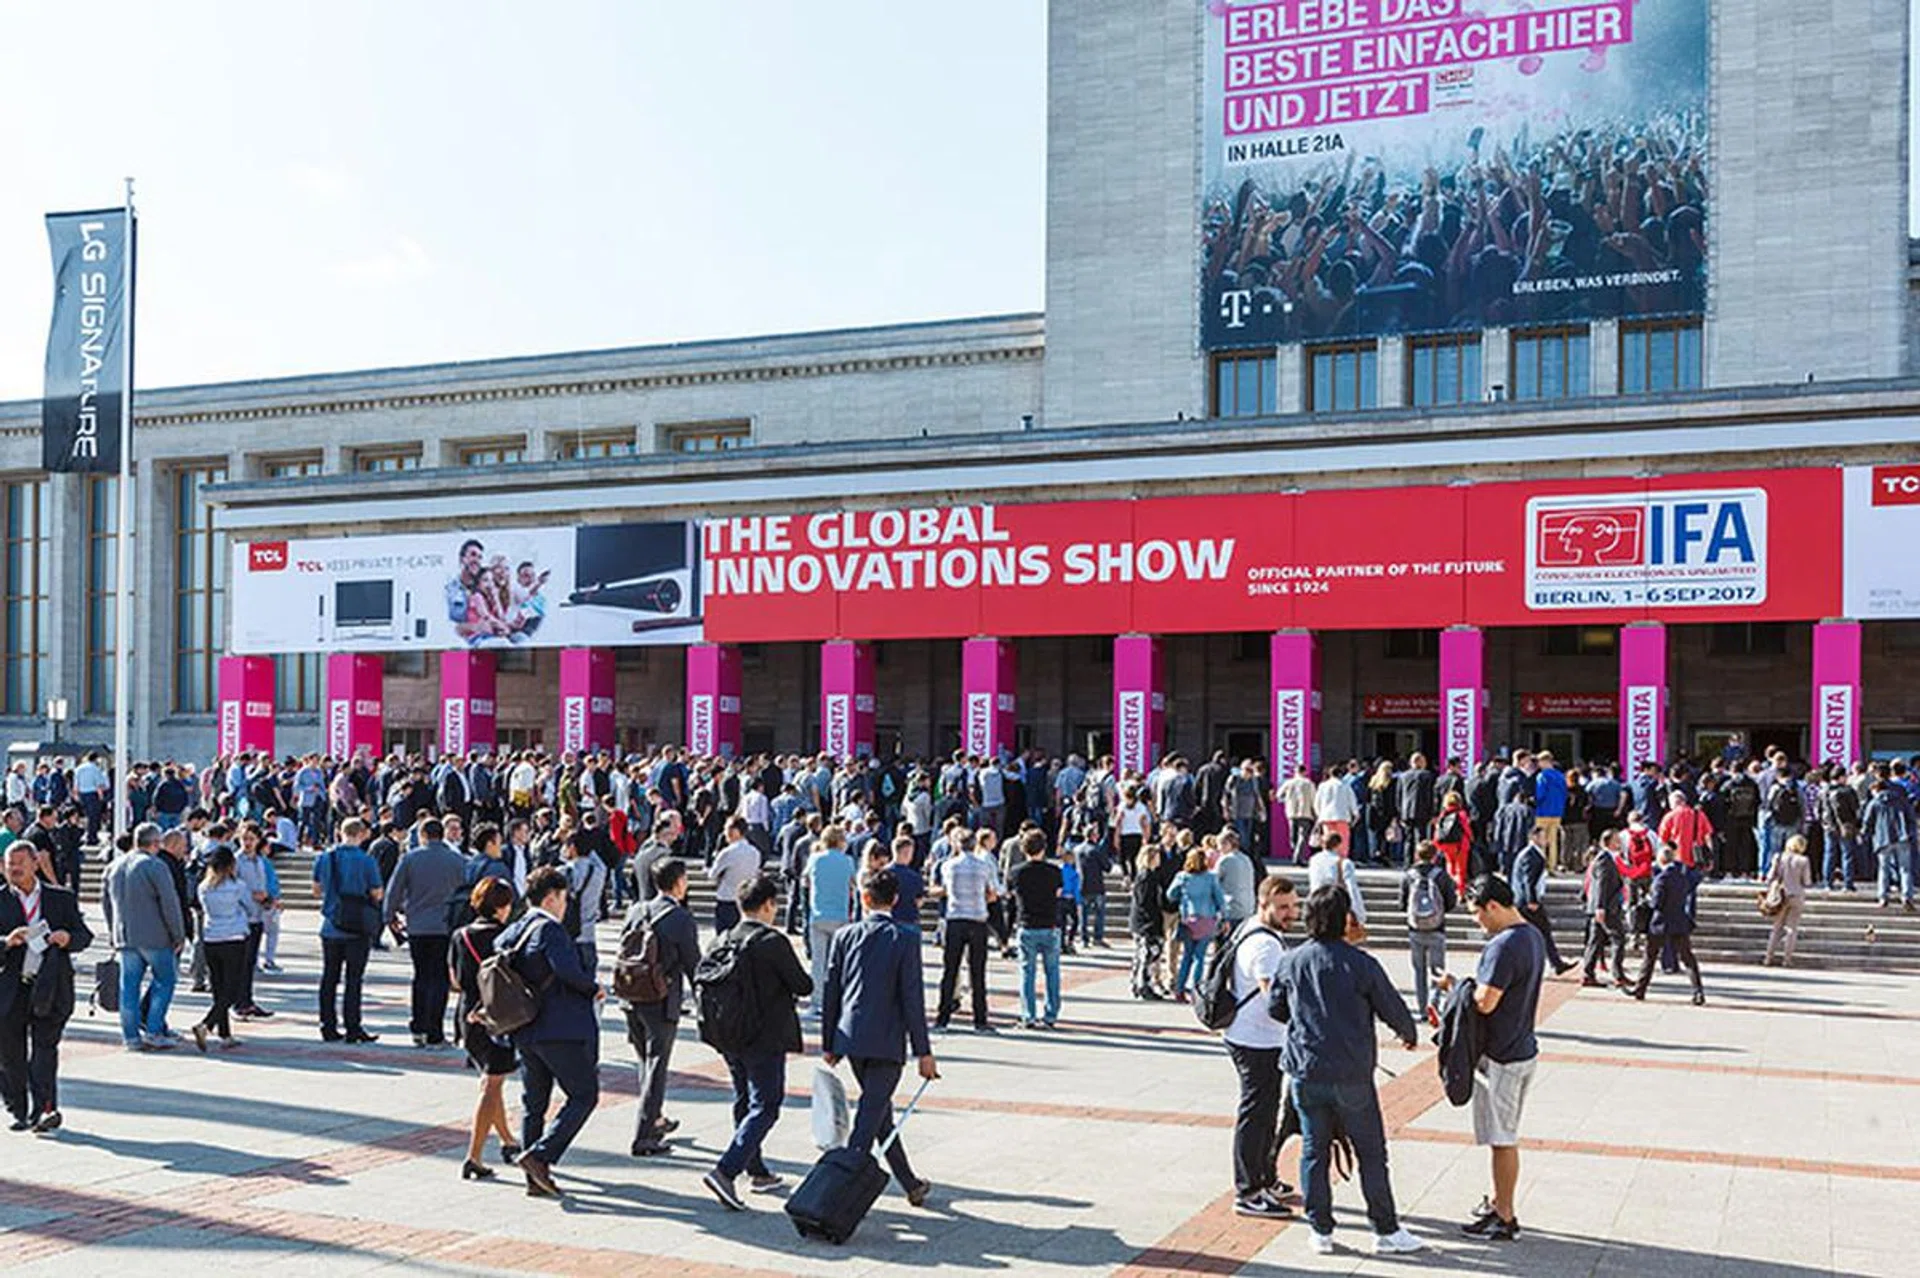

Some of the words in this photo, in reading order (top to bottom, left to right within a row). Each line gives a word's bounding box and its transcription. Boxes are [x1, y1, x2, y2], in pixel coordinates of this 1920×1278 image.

[1228, 0, 1369, 43] ERLEBE
[1380, 0, 1456, 23] DAS
[1228, 41, 1342, 88] BESTE
[1352, 19, 1515, 72] EINFACH
[1528, 6, 1621, 50] HIER
[1227, 93, 1306, 132] UND
[1313, 77, 1423, 123] JETZT
[1228, 144, 1247, 162] IN
[1250, 136, 1309, 159] HALLE
[1312, 133, 1345, 153] 21A
[79, 221, 107, 262] LG
[1576, 275, 1603, 289] WAS
[1881, 476, 1920, 493] TC
[703, 515, 792, 553] THE
[806, 504, 1009, 548] GLOBAL
[1651, 502, 1755, 565] IFA
[253, 549, 283, 563] TCL
[297, 560, 325, 573] TCL
[704, 544, 1050, 596] INNOVATIONS
[1063, 538, 1236, 584] SHOW
[1247, 566, 1312, 580] OFFICIAL
[1316, 562, 1385, 578] PARTNER
[1387, 562, 1407, 576] OF
[1412, 561, 1441, 575] THE
[1445, 559, 1506, 574] FUTURE
[1603, 569, 1686, 579] ELECTRONICS
[1247, 583, 1289, 596] SINCE
[1294, 580, 1330, 594] 1924
[1535, 589, 1616, 605] BERLIN,
[1707, 586, 1757, 602] 2017
[335, 704, 345, 762] AGENTA
[569, 702, 581, 751] GENTA
[832, 699, 845, 768] AGENTA
[1826, 691, 1845, 766] AGENTA
